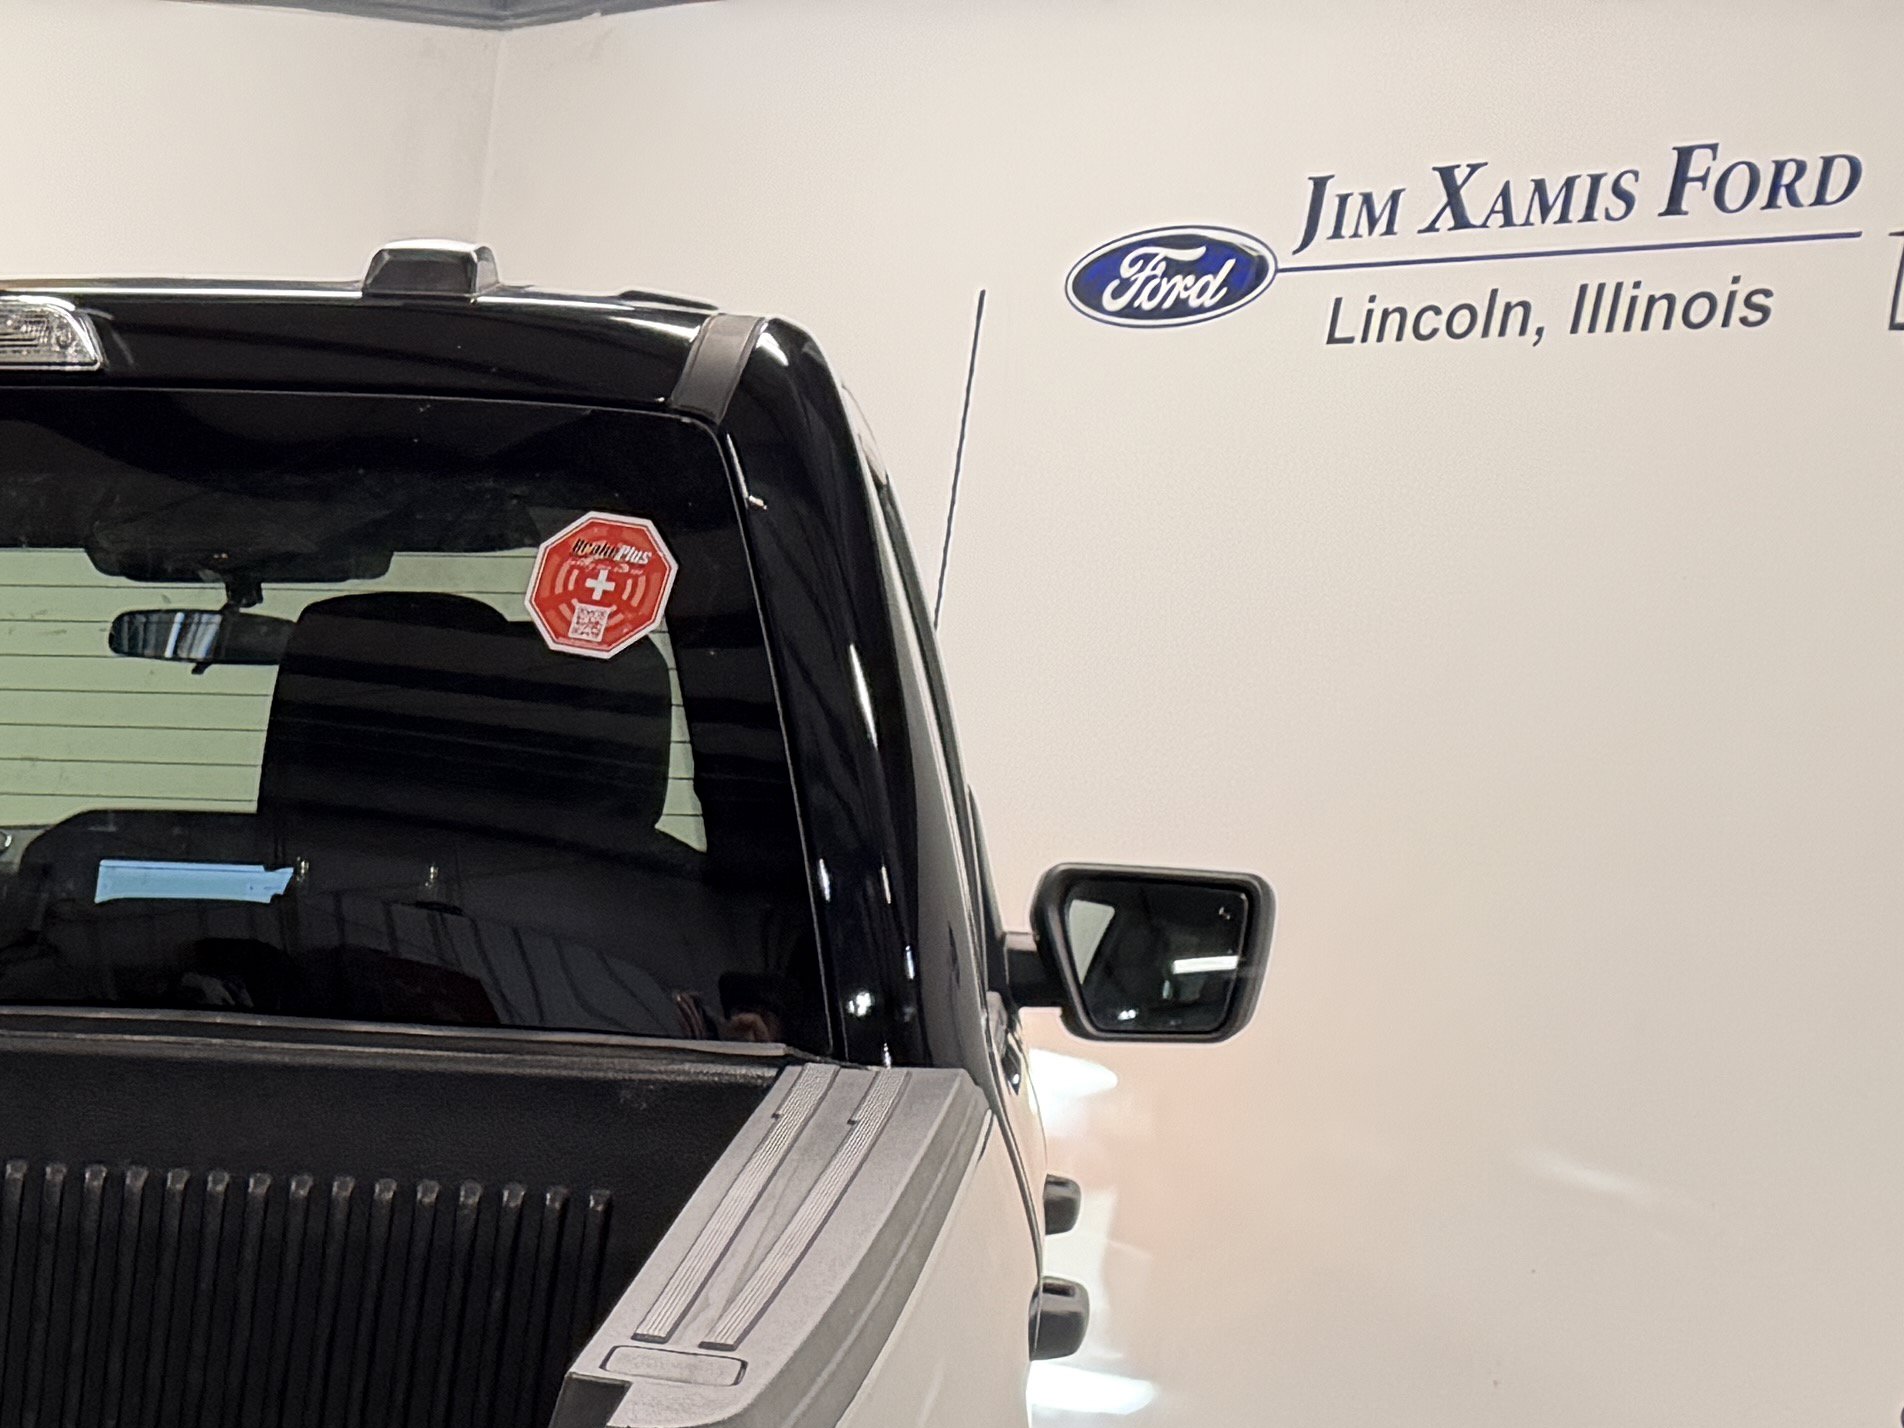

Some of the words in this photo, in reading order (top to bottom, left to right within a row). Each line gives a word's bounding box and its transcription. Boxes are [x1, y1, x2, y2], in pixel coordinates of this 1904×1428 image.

[1291, 174, 1406, 256] JIM
[1416, 161, 1640, 234] XAMIS
[1657, 142, 1863, 217] FORD
[1101, 245, 1236, 313] Ford
[1325, 287, 1545, 347] Lincoln,
[1569, 274, 1774, 335] Illinois
